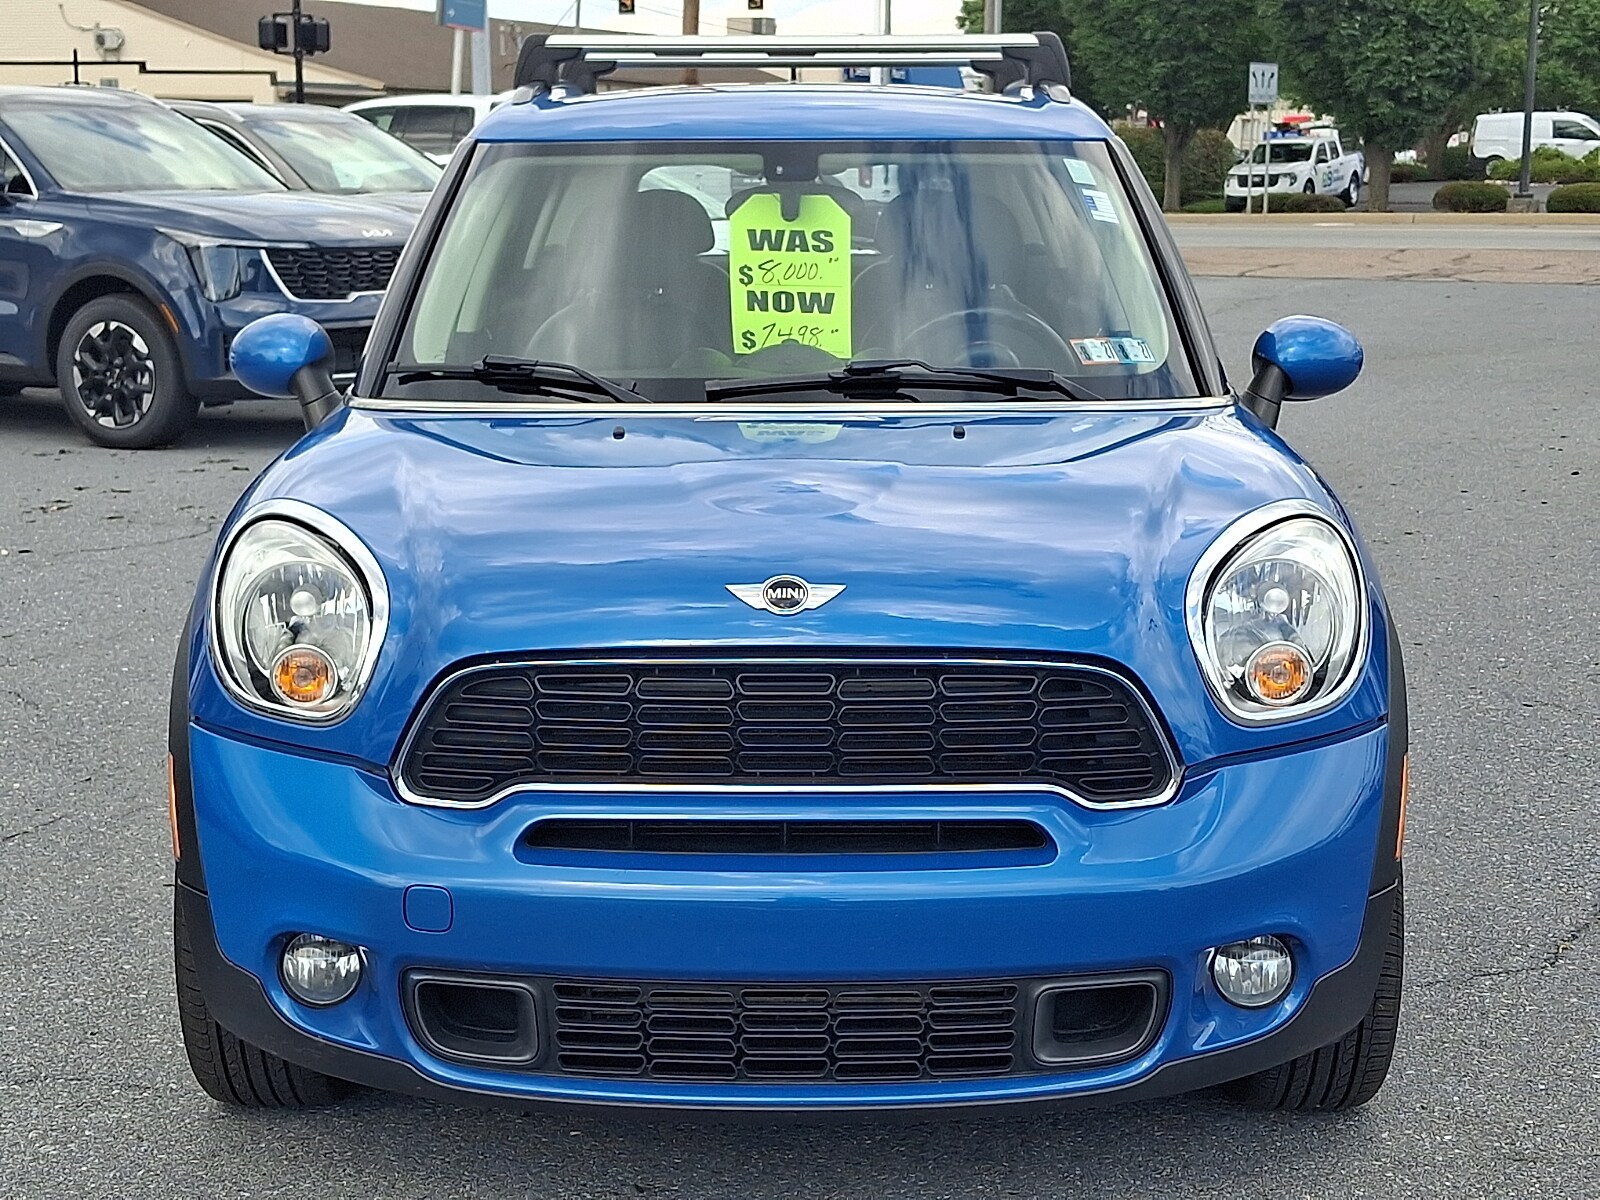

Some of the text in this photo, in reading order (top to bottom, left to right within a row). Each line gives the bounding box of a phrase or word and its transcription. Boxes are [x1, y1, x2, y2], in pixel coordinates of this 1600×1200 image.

[747, 229, 834, 253] WAS
[746, 290, 835, 315] NOW
[767, 587, 805, 599] MINI
